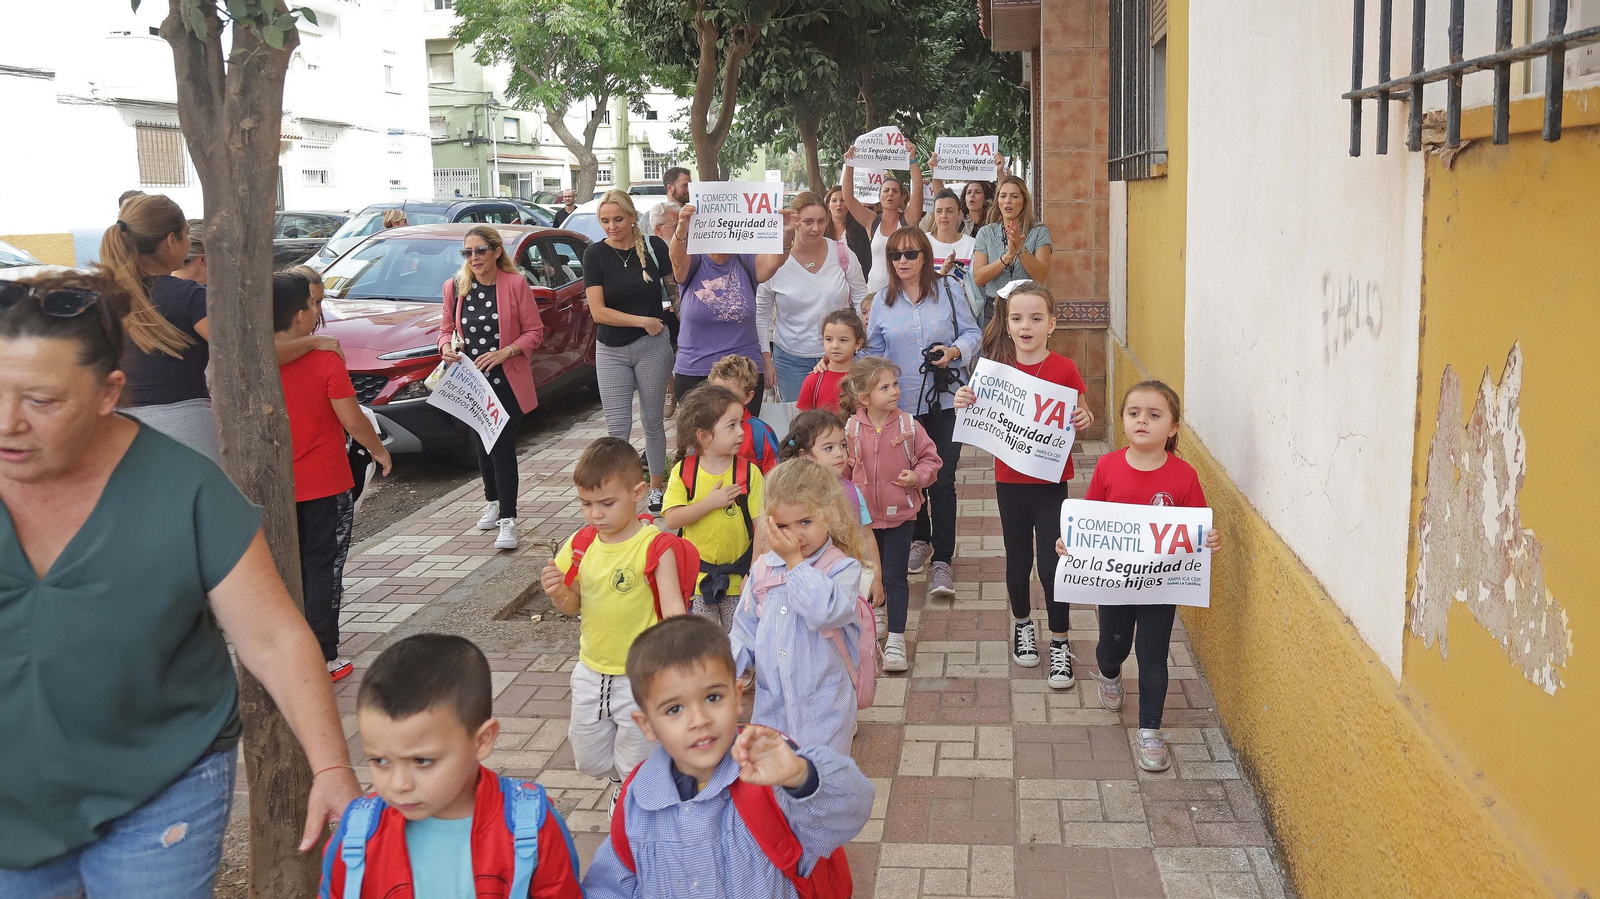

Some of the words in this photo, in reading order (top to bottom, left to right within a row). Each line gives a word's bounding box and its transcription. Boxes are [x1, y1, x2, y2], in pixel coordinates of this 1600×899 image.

[954, 158, 986, 166] Seguridad
[701, 203, 741, 214] INFANTIL
[702, 194, 738, 202] COMEDOR
[693, 230, 726, 240] nuestros
[728, 230, 754, 240] hij@s
[694, 219, 707, 228] Por
[708, 218, 716, 228] la
[717, 218, 766, 230] Seguridad
[768, 218, 778, 228] de
[455, 372, 484, 404] INFANTIL
[462, 366, 486, 394] COMEDOR
[980, 375, 1027, 400] COMEDOR
[438, 390, 469, 410] nuestros
[469, 407, 484, 426] hij@s
[443, 380, 458, 390] Por
[456, 385, 464, 396] la
[464, 392, 492, 427] Seguridad
[490, 427, 496, 436] de
[977, 387, 1026, 417] INFANTIL
[962, 416, 1004, 440] nuestros
[1004, 433, 1033, 454] hij@s
[965, 403, 986, 414] Por
[986, 406, 996, 420] la
[998, 412, 1052, 445] Seguridad
[1052, 436, 1066, 449] de
[1076, 532, 1144, 552] INFANTIL
[1078, 518, 1140, 534] COMEDOR
[1149, 522, 1203, 554] YA!
[1064, 554, 1088, 570] Por
[1090, 556, 1102, 572] la
[1106, 558, 1182, 577] Seguridad
[1184, 558, 1202, 572] de
[1063, 573, 1122, 588] nuestros
[1124, 577, 1162, 590] hij@s
